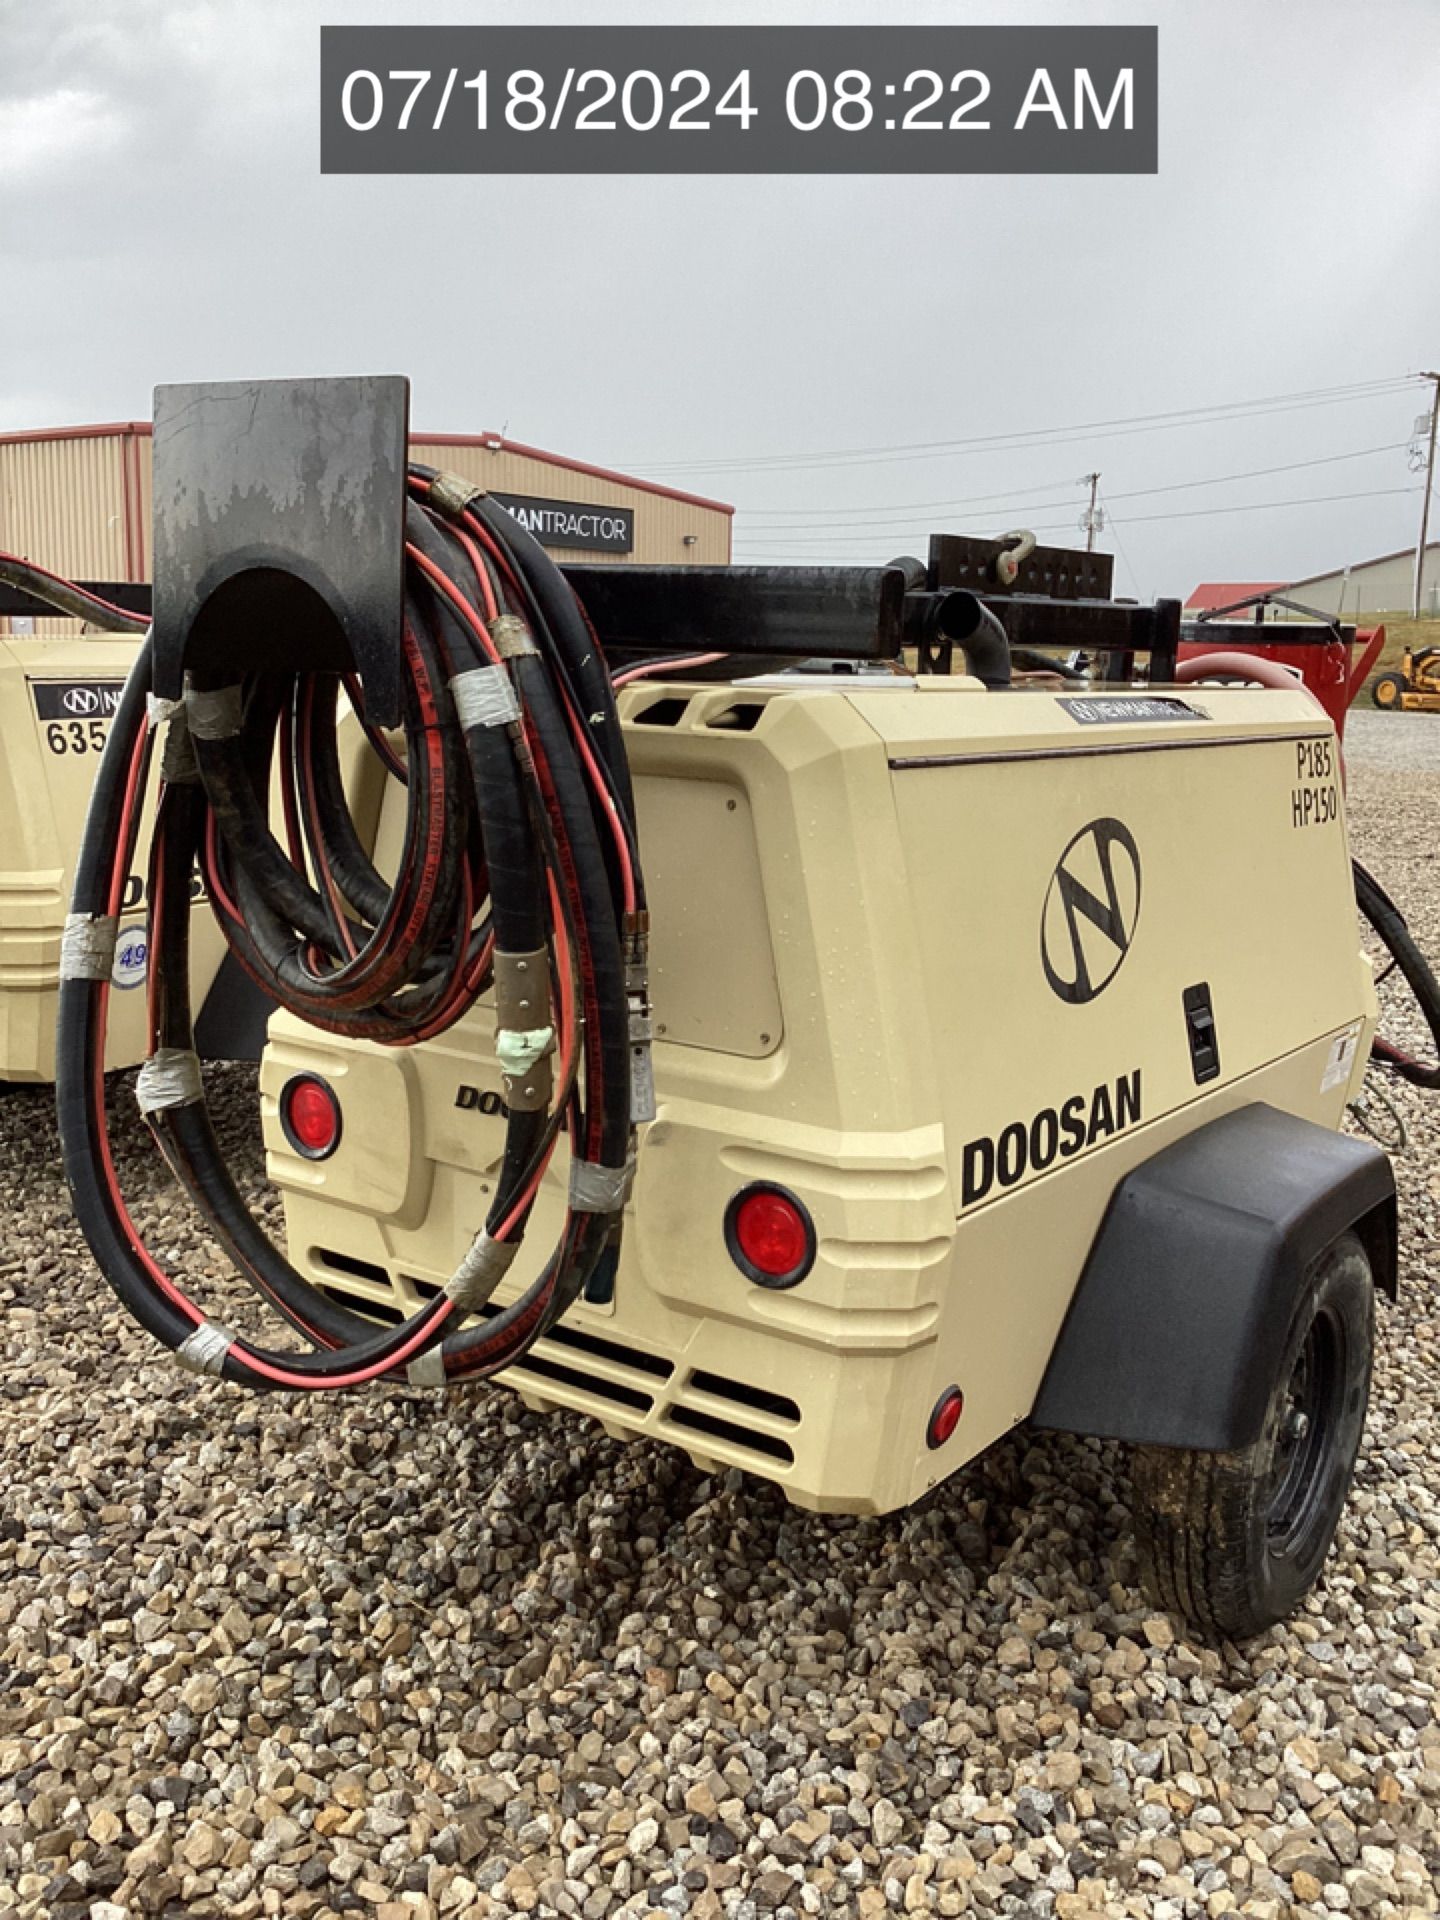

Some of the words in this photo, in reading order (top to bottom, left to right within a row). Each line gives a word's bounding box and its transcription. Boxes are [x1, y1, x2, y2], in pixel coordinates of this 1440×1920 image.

[1296, 741, 1331, 779] P185
[1291, 785, 1337, 828] HP150
[454, 1083, 509, 1119] DO
[962, 1067, 1141, 1209] DOOSAN
